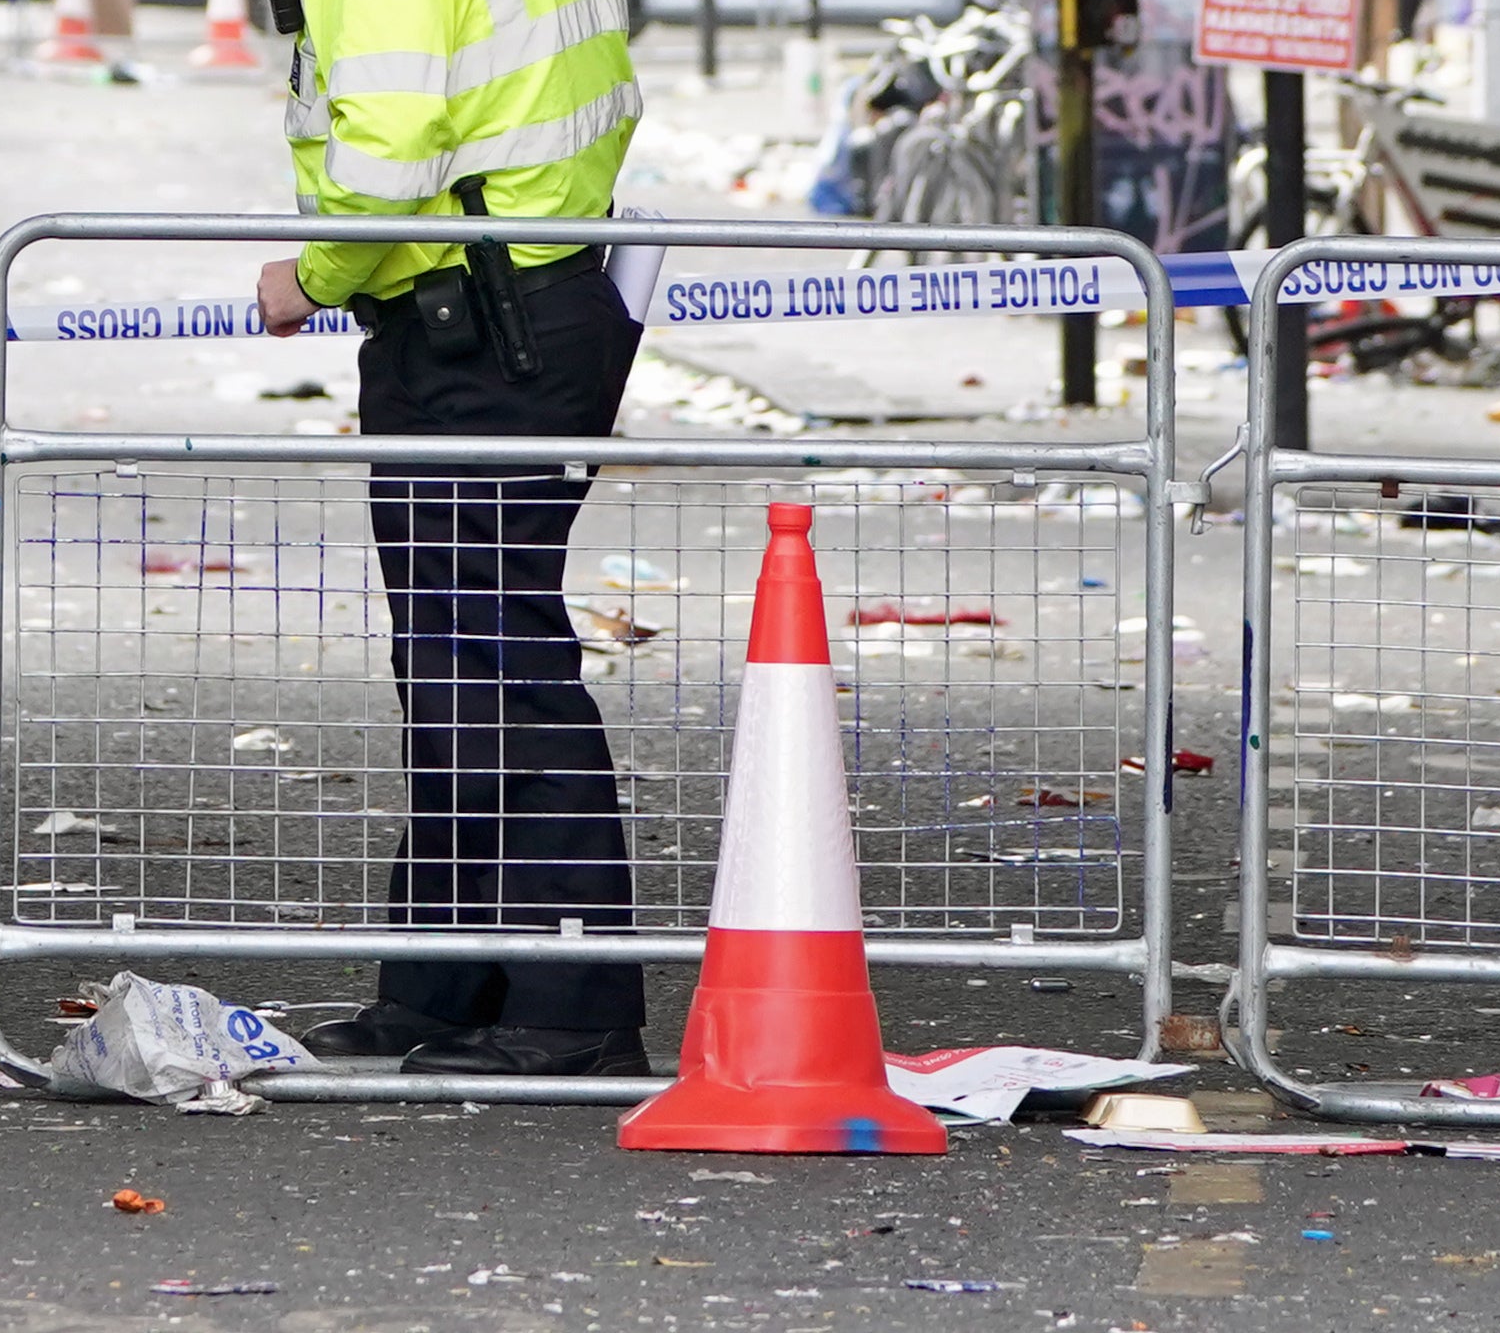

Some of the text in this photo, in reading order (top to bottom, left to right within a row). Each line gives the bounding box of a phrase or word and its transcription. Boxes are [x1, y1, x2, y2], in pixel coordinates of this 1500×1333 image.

[666, 264, 1101, 322] POLICE LINE DO NOT CROSS
[57, 306, 163, 341] CROSS
[171, 303, 235, 338] NOT
